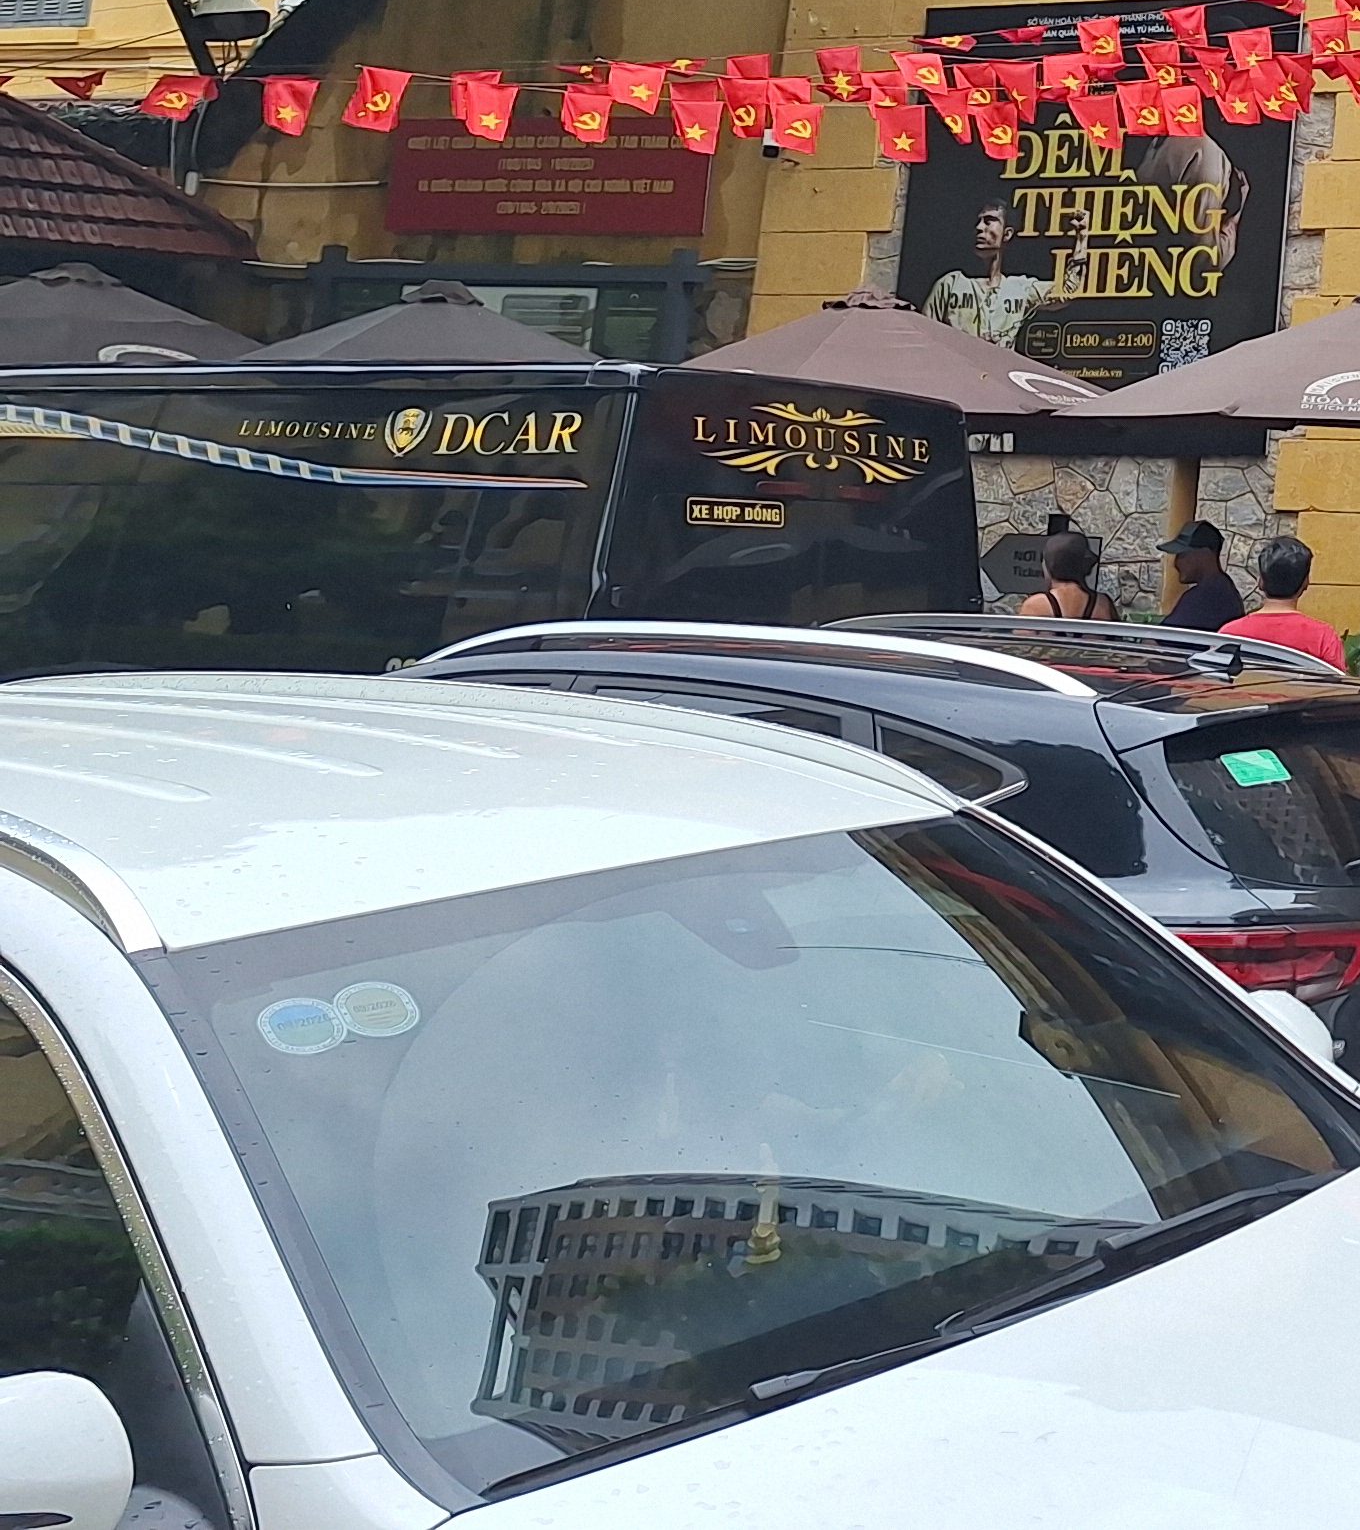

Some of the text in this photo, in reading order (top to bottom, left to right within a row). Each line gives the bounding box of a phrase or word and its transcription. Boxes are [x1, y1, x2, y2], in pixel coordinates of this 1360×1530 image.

[1012, 169, 1227, 237] THIÊNG
[1048, 233, 1222, 298] LIÊNG
[1117, 333, 1153, 347] 21:00
[238, 420, 377, 440] LIMOUSINE
[432, 411, 582, 455] DCAR
[693, 416, 931, 464] LIMOUSINE
[691, 504, 710, 519] XE
